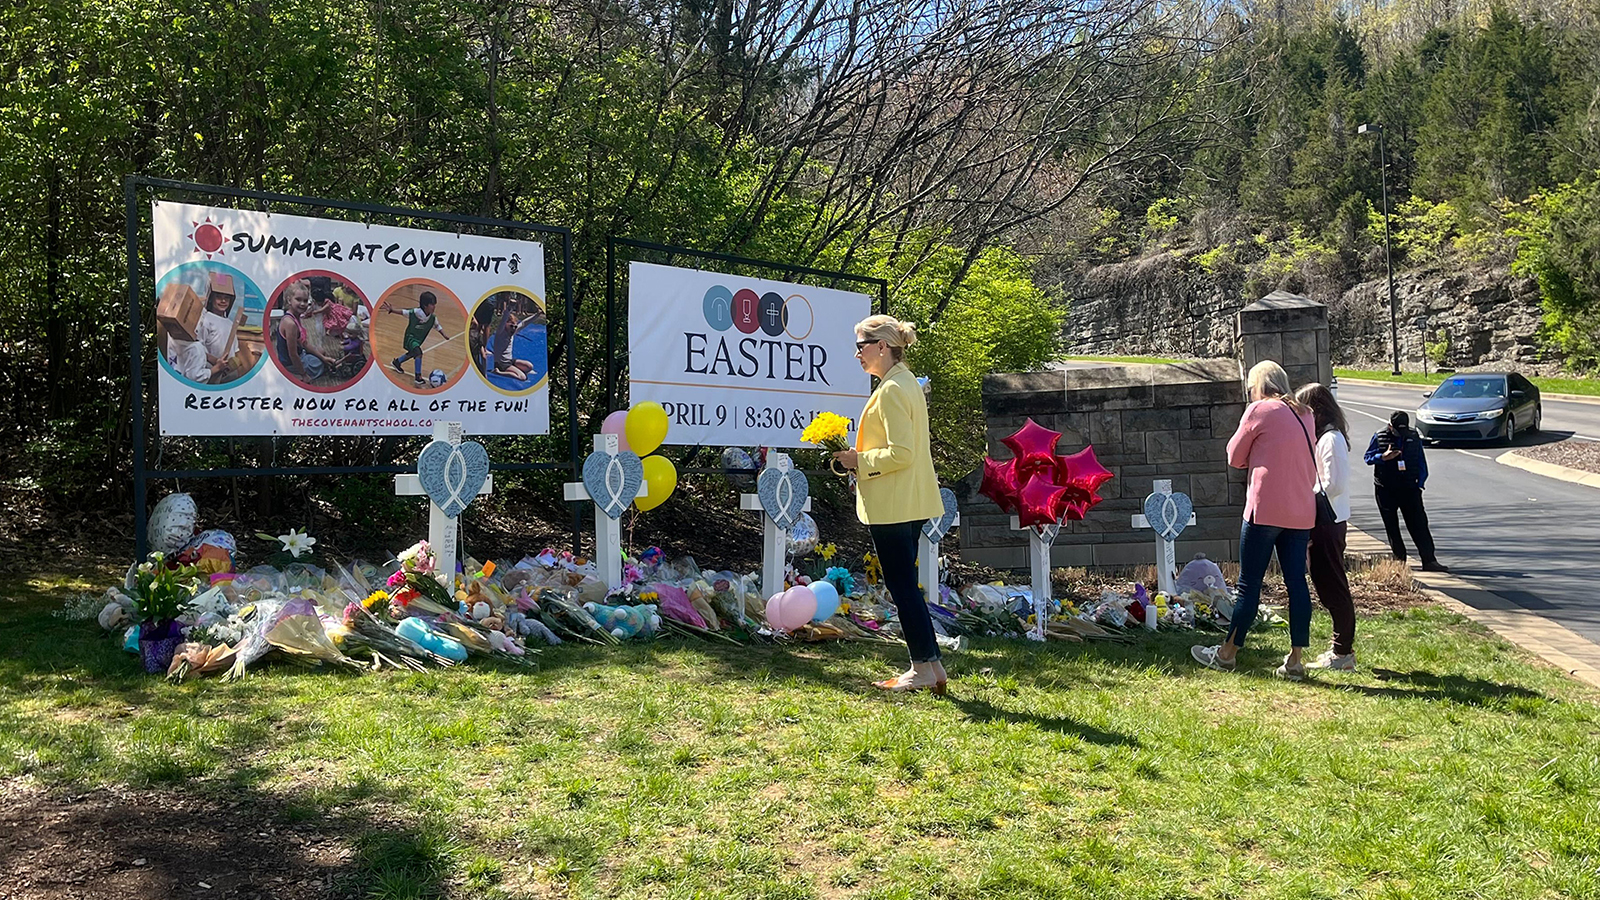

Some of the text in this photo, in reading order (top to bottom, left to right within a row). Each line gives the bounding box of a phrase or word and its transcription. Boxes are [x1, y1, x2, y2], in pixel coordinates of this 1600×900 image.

[232, 232, 506, 274] SUMMER AT COVENANT
[684, 332, 830, 386] EASTER
[184, 393, 528, 413] REGISTER NOW FOR ALL OF THE FUN!
[661, 402, 710, 426] PRIL
[716, 405, 727, 427] 9
[745, 406, 785, 429] 8:30
[790, 409, 805, 430] &
[291, 419, 441, 427] THECOVENANTSCHOOL.CO
